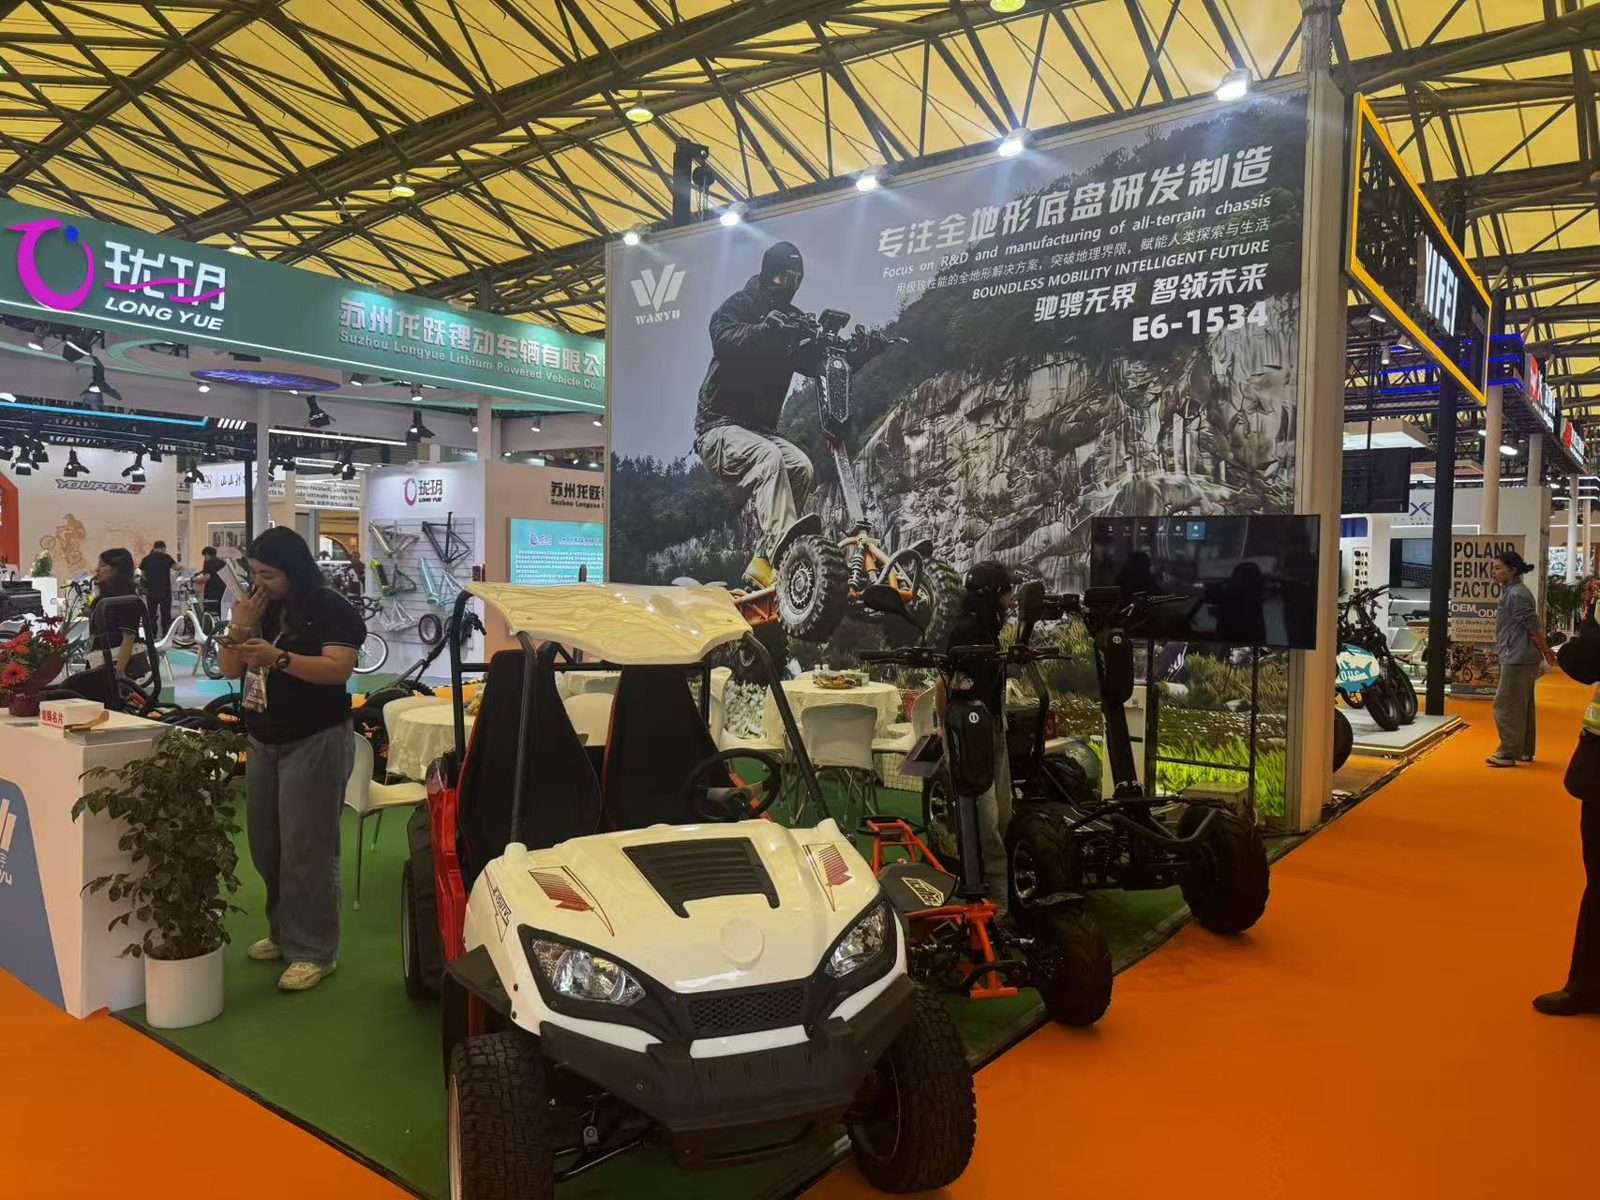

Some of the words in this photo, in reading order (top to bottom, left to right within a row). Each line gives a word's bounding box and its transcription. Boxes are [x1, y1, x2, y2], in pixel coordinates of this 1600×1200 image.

[877, 145, 1273, 259] 专注全地形底盘研发制造
[883, 265, 914, 279] Focus
[920, 261, 935, 272] on
[940, 252, 969, 268] R&D
[975, 245, 999, 262] and
[1005, 227, 1102, 256] manufacturing
[1109, 219, 1127, 236] of
[1132, 206, 1206, 232] all-terrain
[1215, 193, 1272, 217] chassis
[972, 276, 1045, 300] BOUNDLESS
[1047, 265, 1113, 290] MOBILITY
[1114, 249, 1207, 276] INTELLIGENT
[1209, 239, 1270, 261] FUTURE
[1034, 281, 1138, 323] 驰骋无界
[1150, 262, 1270, 306] 智领未来
[105, 297, 172, 321] LONG
[178, 311, 224, 331] YUE
[339, 299, 606, 378] 苏州龙跃锂动车辆有限公
[635, 309, 681, 325] WANYU
[1132, 301, 1269, 342] E6-1534
[339, 331, 389, 351] Suzhou
[394, 340, 446, 361] Longyue
[450, 351, 493, 371] Lithium
[496, 361, 542, 380] Powered
[545, 370, 581, 388] Vehicle
[551, 499, 574, 507] Suzhou
[1453, 581, 1502, 599] FACTO
[1478, 608, 1497, 618] OD
